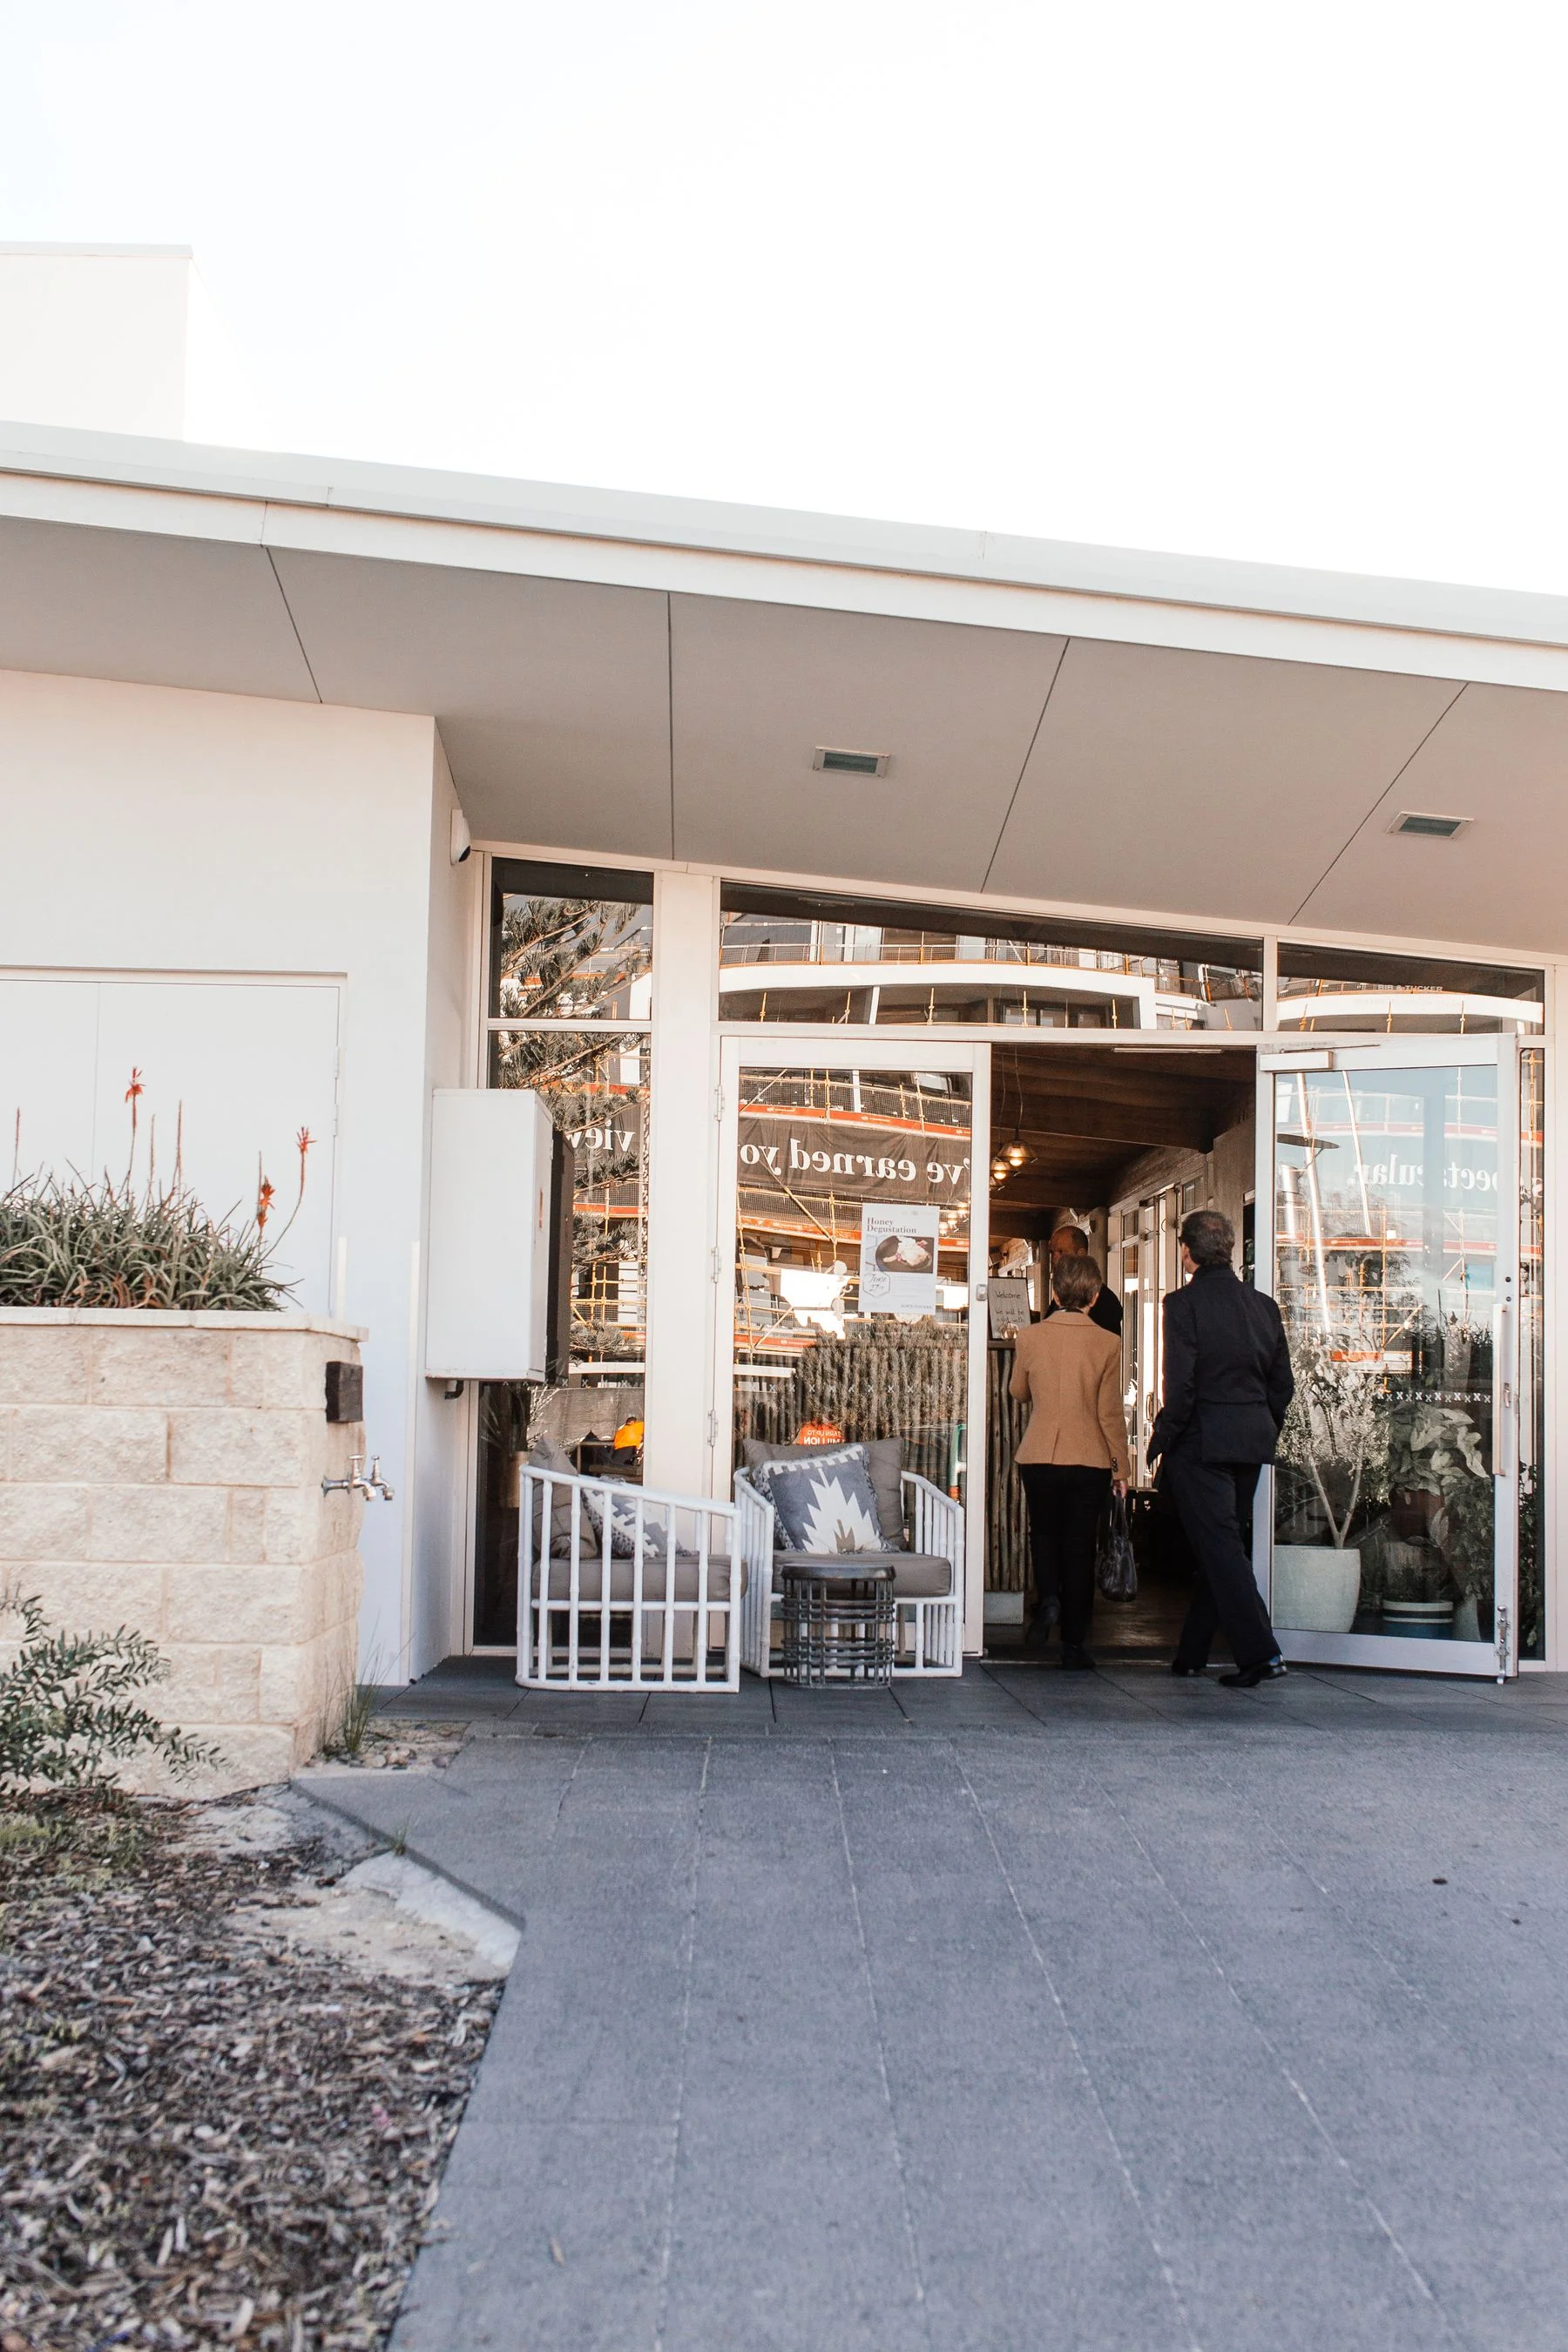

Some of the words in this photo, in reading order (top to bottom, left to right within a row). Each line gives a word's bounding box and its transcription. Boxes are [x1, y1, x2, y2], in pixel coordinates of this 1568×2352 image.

[867, 1217, 894, 1227] Honey
[867, 1225, 916, 1233] Degustation
[995, 1290, 1021, 1299] Welcome
